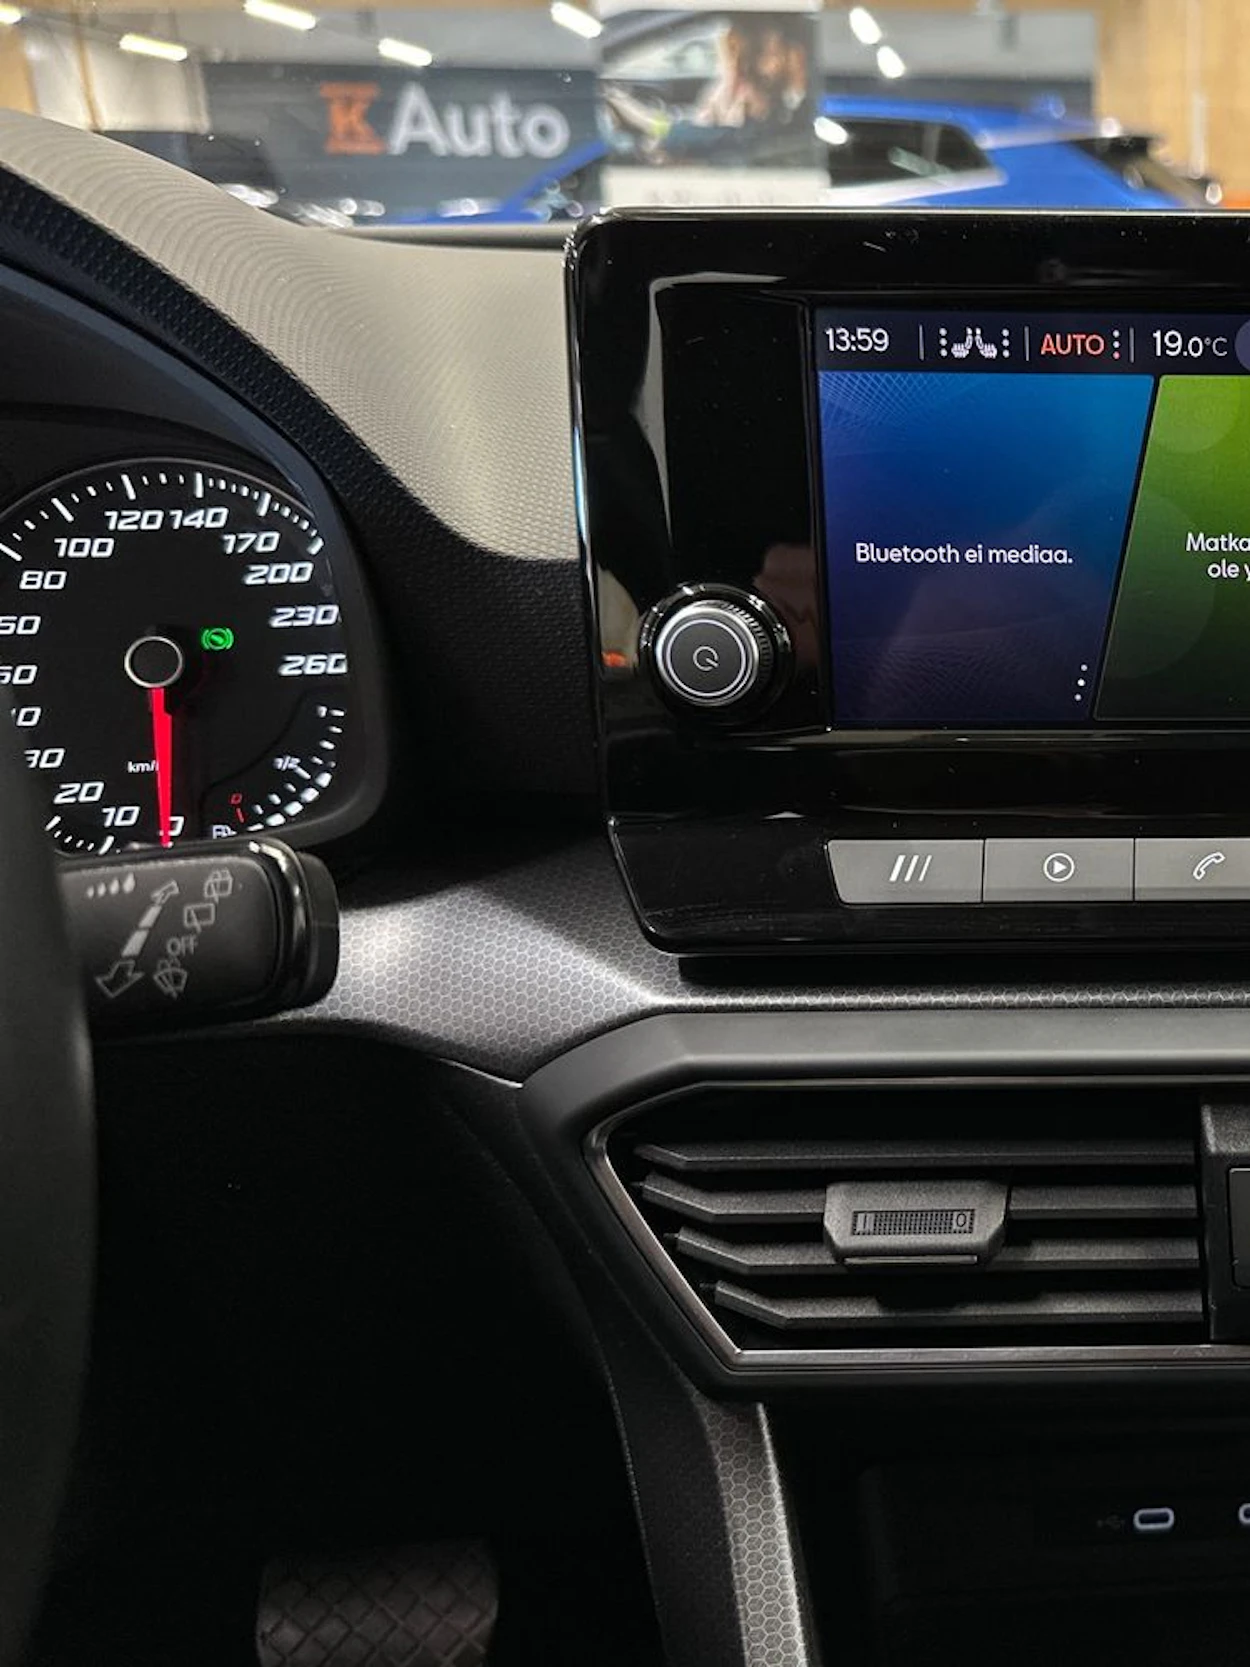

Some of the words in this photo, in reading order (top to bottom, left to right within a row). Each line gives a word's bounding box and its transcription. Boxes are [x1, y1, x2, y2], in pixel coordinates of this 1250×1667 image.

[320, 82, 385, 155] K
[388, 83, 571, 158] Auto
[825, 327, 890, 352] 13:59
[1040, 333, 1104, 355] AUTO
[1152, 330, 1228, 358] 19.0°C
[104, 510, 164, 531] 120
[169, 507, 229, 529] 140
[54, 537, 115, 558] 100
[222, 531, 280, 554] 170
[855, 543, 960, 563] Bluetooth
[964, 544, 983, 563] ei
[988, 544, 1073, 563] mediaa.
[244, 562, 314, 585] 200
[1207, 558, 1239, 578] ole
[19, 570, 67, 590] 80
[269, 604, 340, 628] 230
[278, 653, 348, 676] 260
[24, 747, 66, 769] 30
[53, 781, 104, 804] 20
[102, 805, 140, 827] 10
[167, 935, 198, 957] OFF
